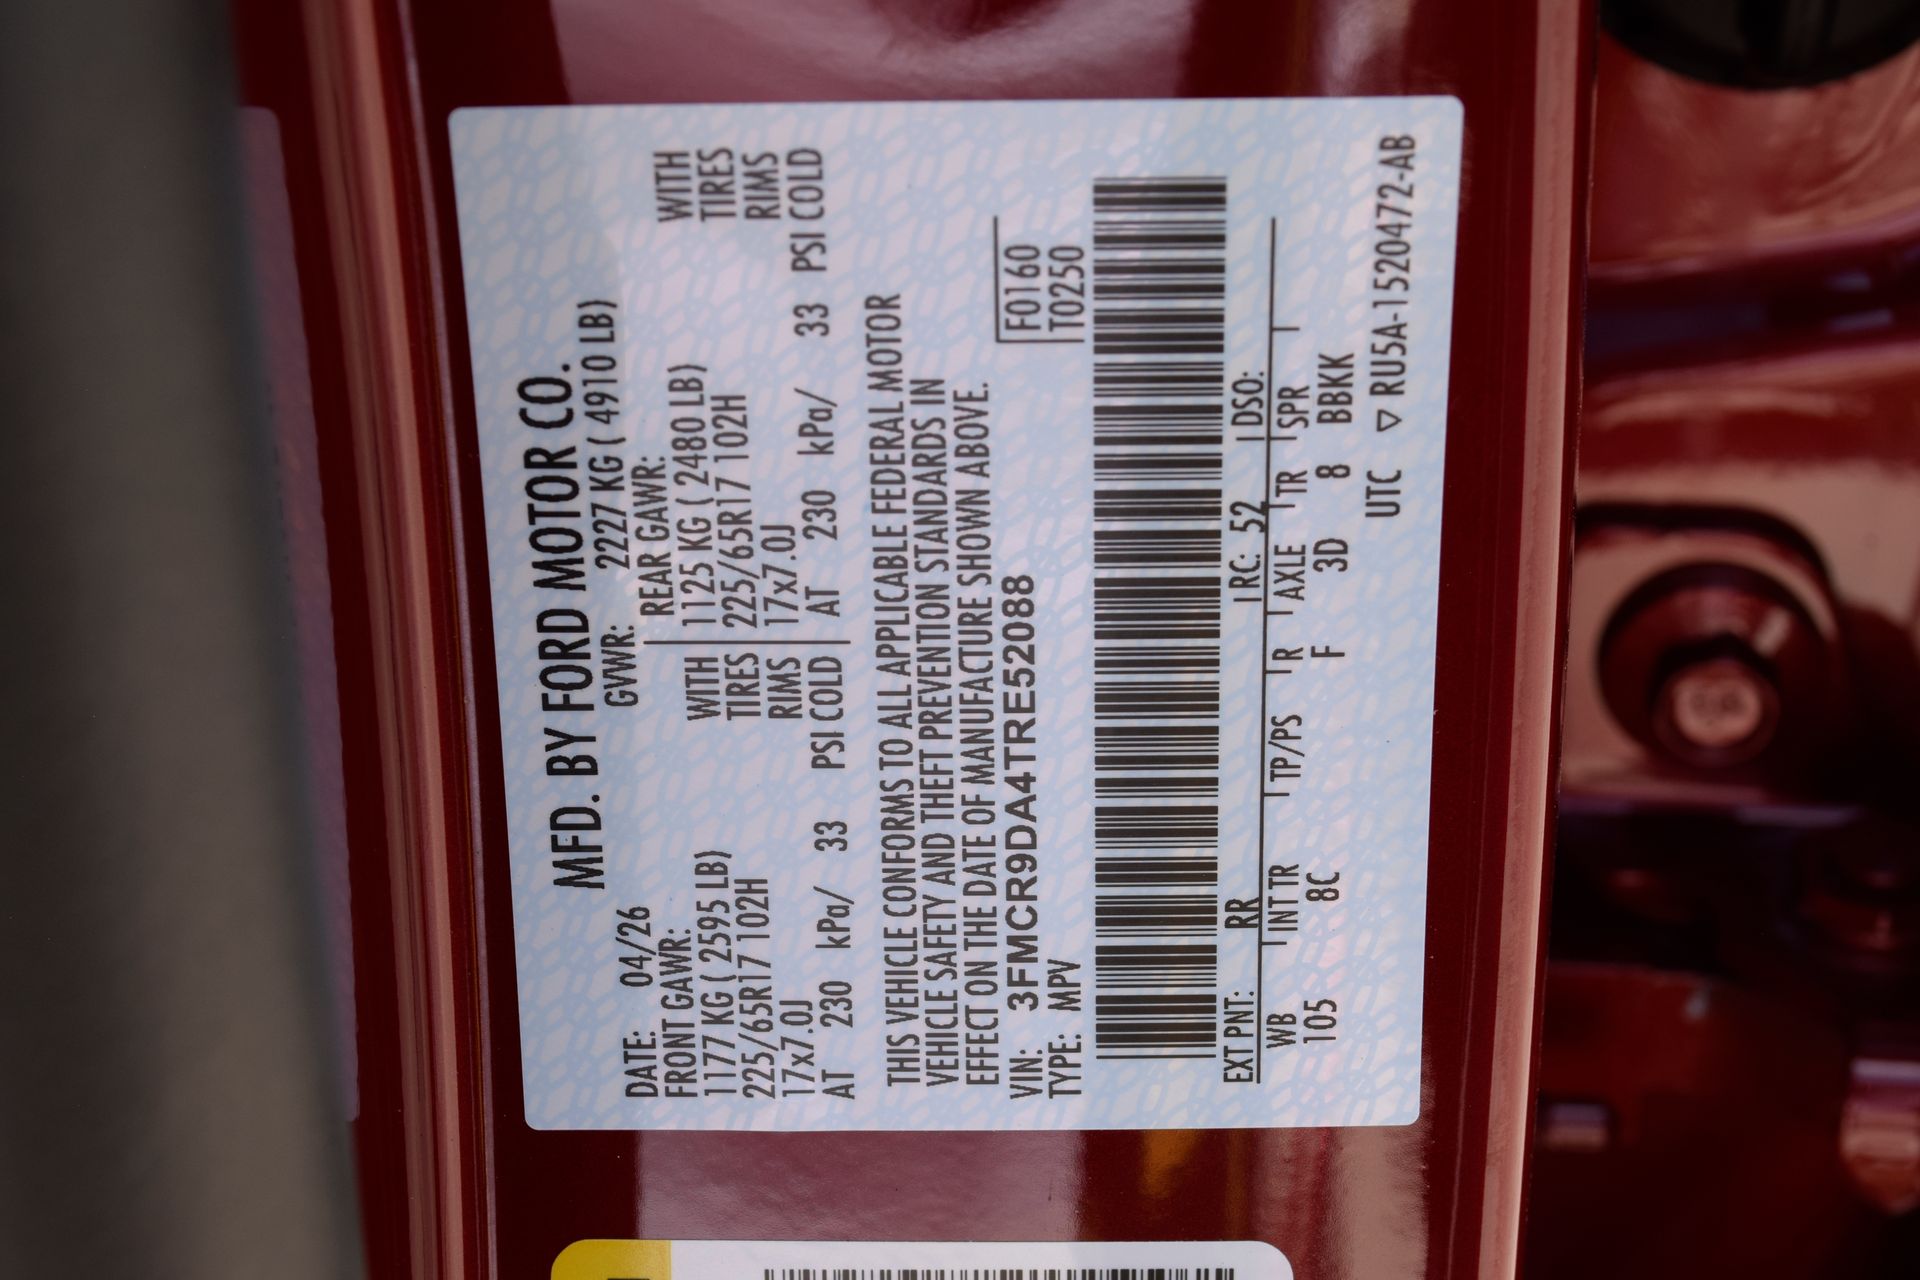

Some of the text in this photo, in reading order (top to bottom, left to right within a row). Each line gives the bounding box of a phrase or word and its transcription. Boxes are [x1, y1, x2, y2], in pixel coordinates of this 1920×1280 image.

[654, 152, 692, 222] WITH
[697, 148, 736, 221] TIRES
[742, 153, 780, 219] RIMS
[1004, 245, 1041, 330] F0160
[1048, 246, 1084, 332] T0250
[1369, 136, 1415, 396] RU5A-1520472-AB
[577, 300, 617, 343] LB)
[581, 355, 619, 424] 4910
[668, 364, 707, 406] LB)
[786, 149, 840, 617] AT 230 kPa/ 33 PSI COLD
[1231, 372, 1264, 426] DSO:
[1277, 386, 1309, 428] SPR
[1317, 354, 1354, 423] BBKK
[588, 456, 624, 491] KG
[670, 417, 709, 485] 2480
[1275, 471, 1307, 497] TR
[1315, 464, 1350, 478] 8
[711, 396, 760, 628] 225/65R17 102H
[1365, 470, 1401, 517] UTC
[591, 502, 630, 569] 2227
[631, 457, 674, 615] REAR GAWR:
[677, 517, 712, 551] KG
[1229, 501, 1267, 588] RC: 52
[1313, 538, 1348, 572] 3D
[679, 563, 716, 626] 1125
[760, 525, 799, 626] 17x7.0J
[1273, 545, 1306, 601] AXLE
[517, 364, 605, 889] MFD. BY FORD MOTOR CO.
[1272, 648, 1303, 660] R
[1311, 646, 1345, 657] F
[600, 626, 638, 706] GVWR:
[684, 657, 721, 721] WITH
[724, 653, 761, 721] TIRES
[766, 657, 802, 718] RIMS
[865, 294, 920, 1087] THIS VEHICLE CONFORMS TO ALL APPLICABLE FEDERAL MOTOR
[910, 379, 959, 1087] VEHICLE SAFETY AND THEFT PREVENTION STANDARDS IN
[953, 383, 999, 1084] EFFECT ON THE DATE OF MANUFACTURE SHOWN ABOVE.
[1268, 715, 1305, 782] TP/PS
[694, 851, 732, 888] LB)
[1001, 575, 1043, 1099] VIN: 3FMCR9DA4TRE52088
[808, 656, 855, 1099] AT 230 kPa/ 33 PSI COLD
[1268, 864, 1299, 931] INT TR
[1305, 872, 1339, 901] 8C
[696, 900, 732, 963] 2595
[615, 906, 658, 1097] DATE: 04/26
[658, 929, 698, 1097] FRONT GAWR:
[700, 992, 734, 1024] KG
[734, 879, 779, 1099] 225/65R17 102H
[1223, 897, 1259, 1082] EXT PNT: RR
[1303, 999, 1337, 1043] 105
[779, 1001, 815, 1097] 17x7.0J
[1047, 959, 1081, 1099] TYPE: MPV
[1266, 1014, 1296, 1048] WB
[702, 1035, 737, 1096] 1177
